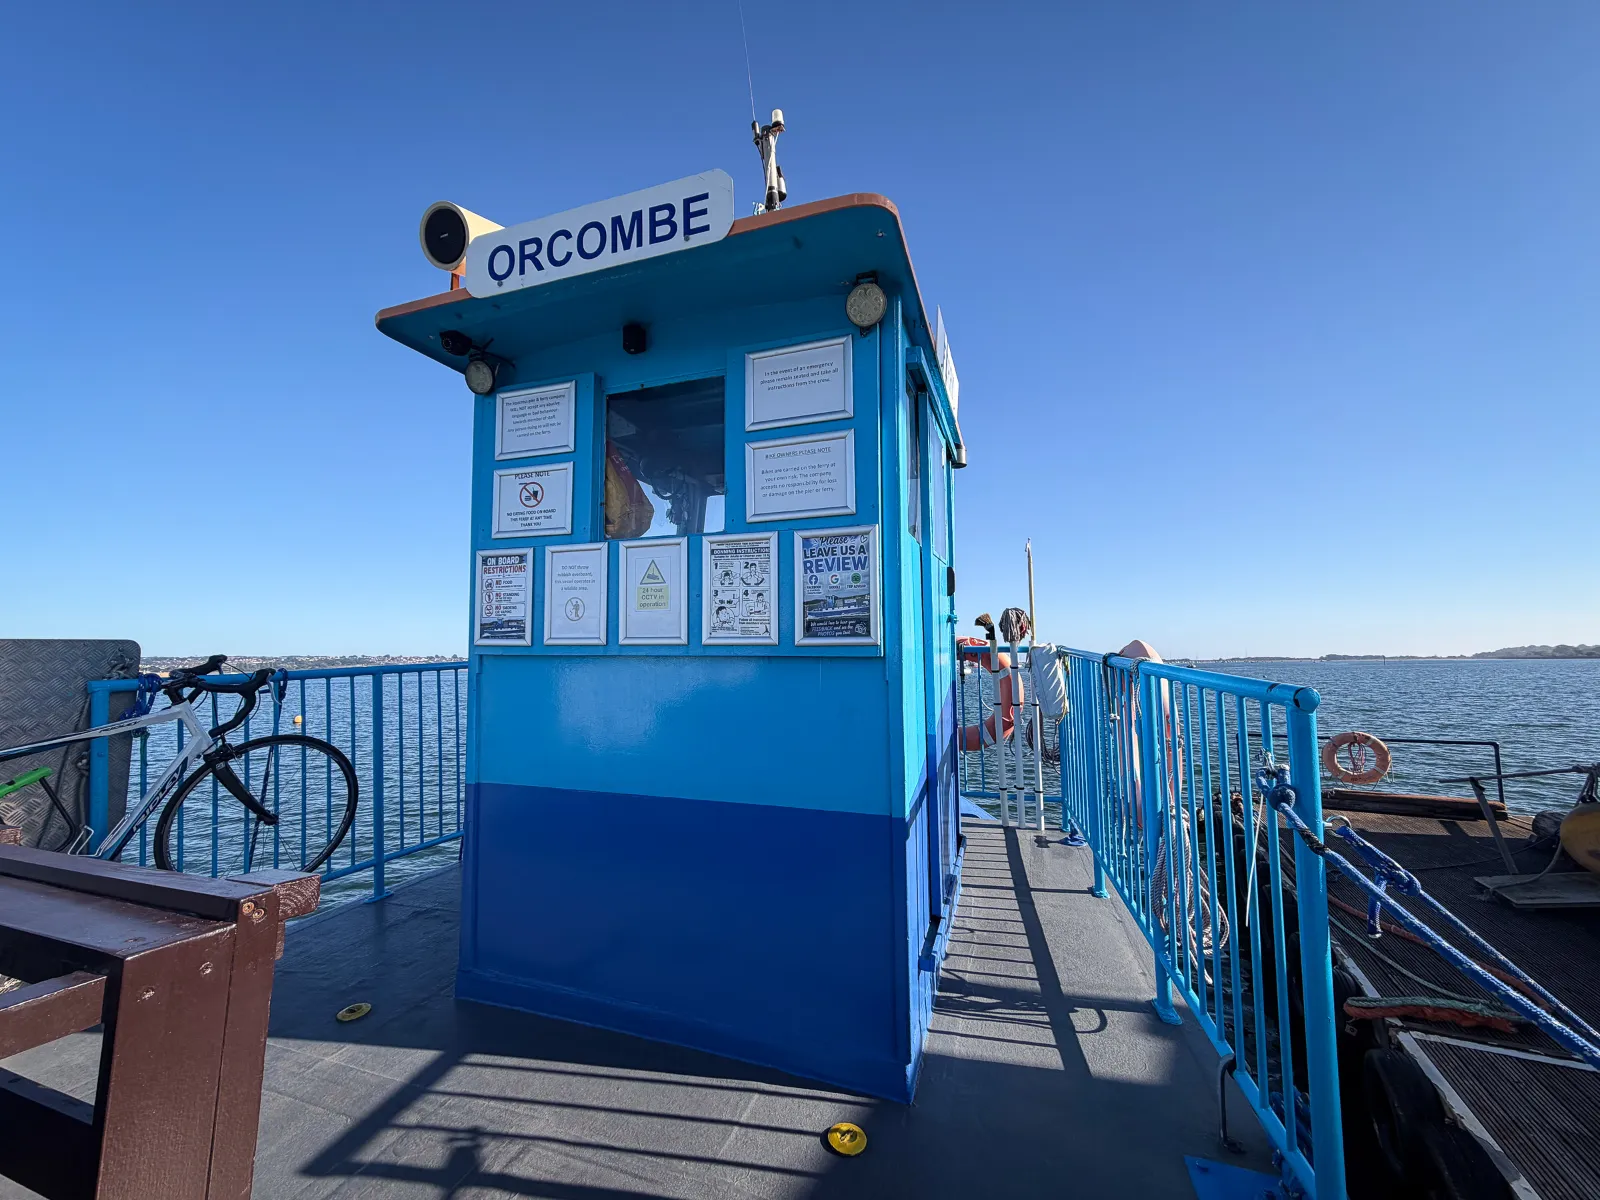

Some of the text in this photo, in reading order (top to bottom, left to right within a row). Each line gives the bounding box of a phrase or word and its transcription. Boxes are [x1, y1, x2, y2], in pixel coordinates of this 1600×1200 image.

[488, 192, 710, 281] ORCOMBE
[786, 479, 818, 488] responsibility
[820, 537, 848, 545] Please
[804, 545, 866, 559] LEAVE US A
[498, 556, 519, 564] BOARD
[804, 556, 867, 574] REVIEW
[484, 565, 526, 574] RESTRICTIONS
[132, 764, 183, 833] RIDLEY
